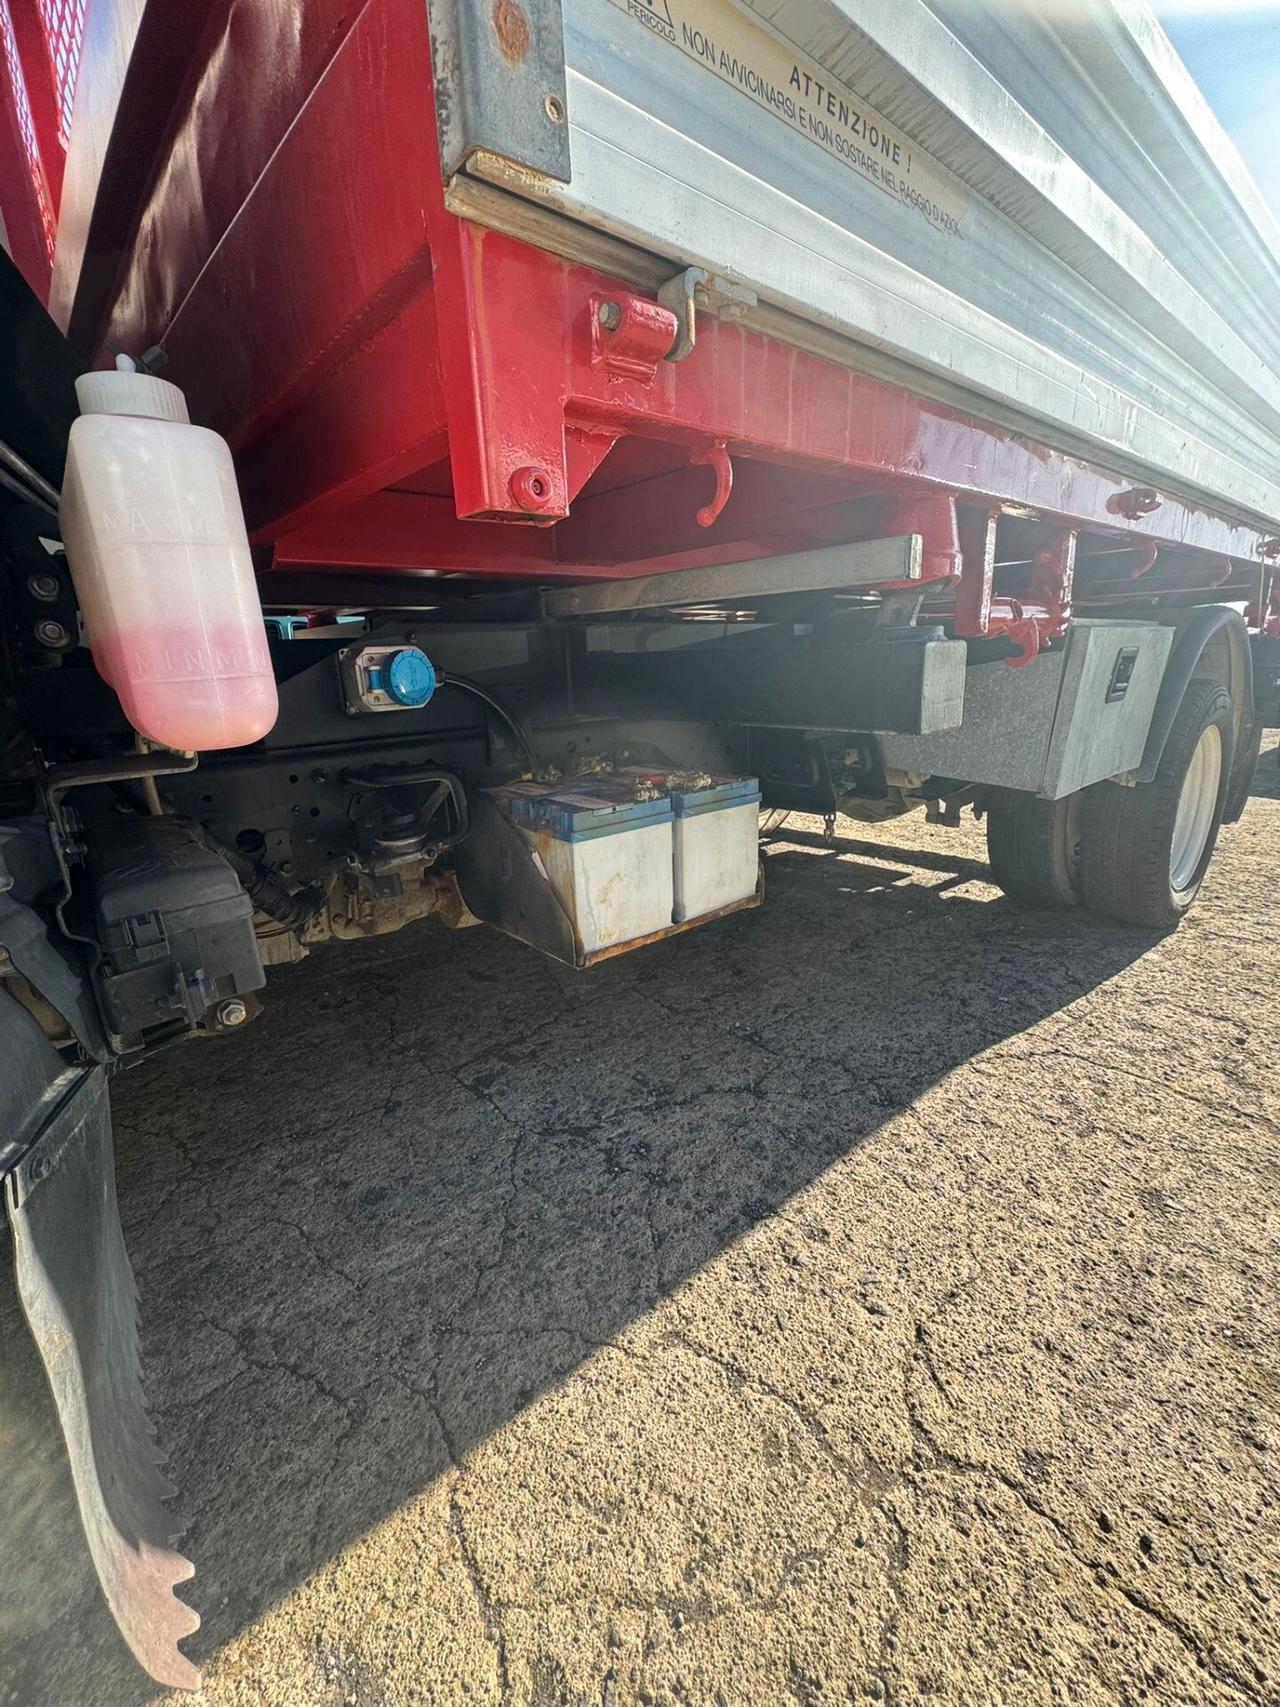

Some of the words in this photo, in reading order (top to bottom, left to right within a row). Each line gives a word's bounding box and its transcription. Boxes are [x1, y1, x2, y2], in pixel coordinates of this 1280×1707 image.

[627, 0, 676, 42] PERICOLO
[682, 21, 716, 65] NON
[719, 49, 797, 123] AVVICINARSI
[798, 106, 808, 129] E
[808, 113, 834, 148] NON
[834, 133, 880, 181] SOSTARE
[880, 166, 899, 194] NEL
[789, 64, 901, 166] ATTENZIONE
[906, 154, 912, 174] !
